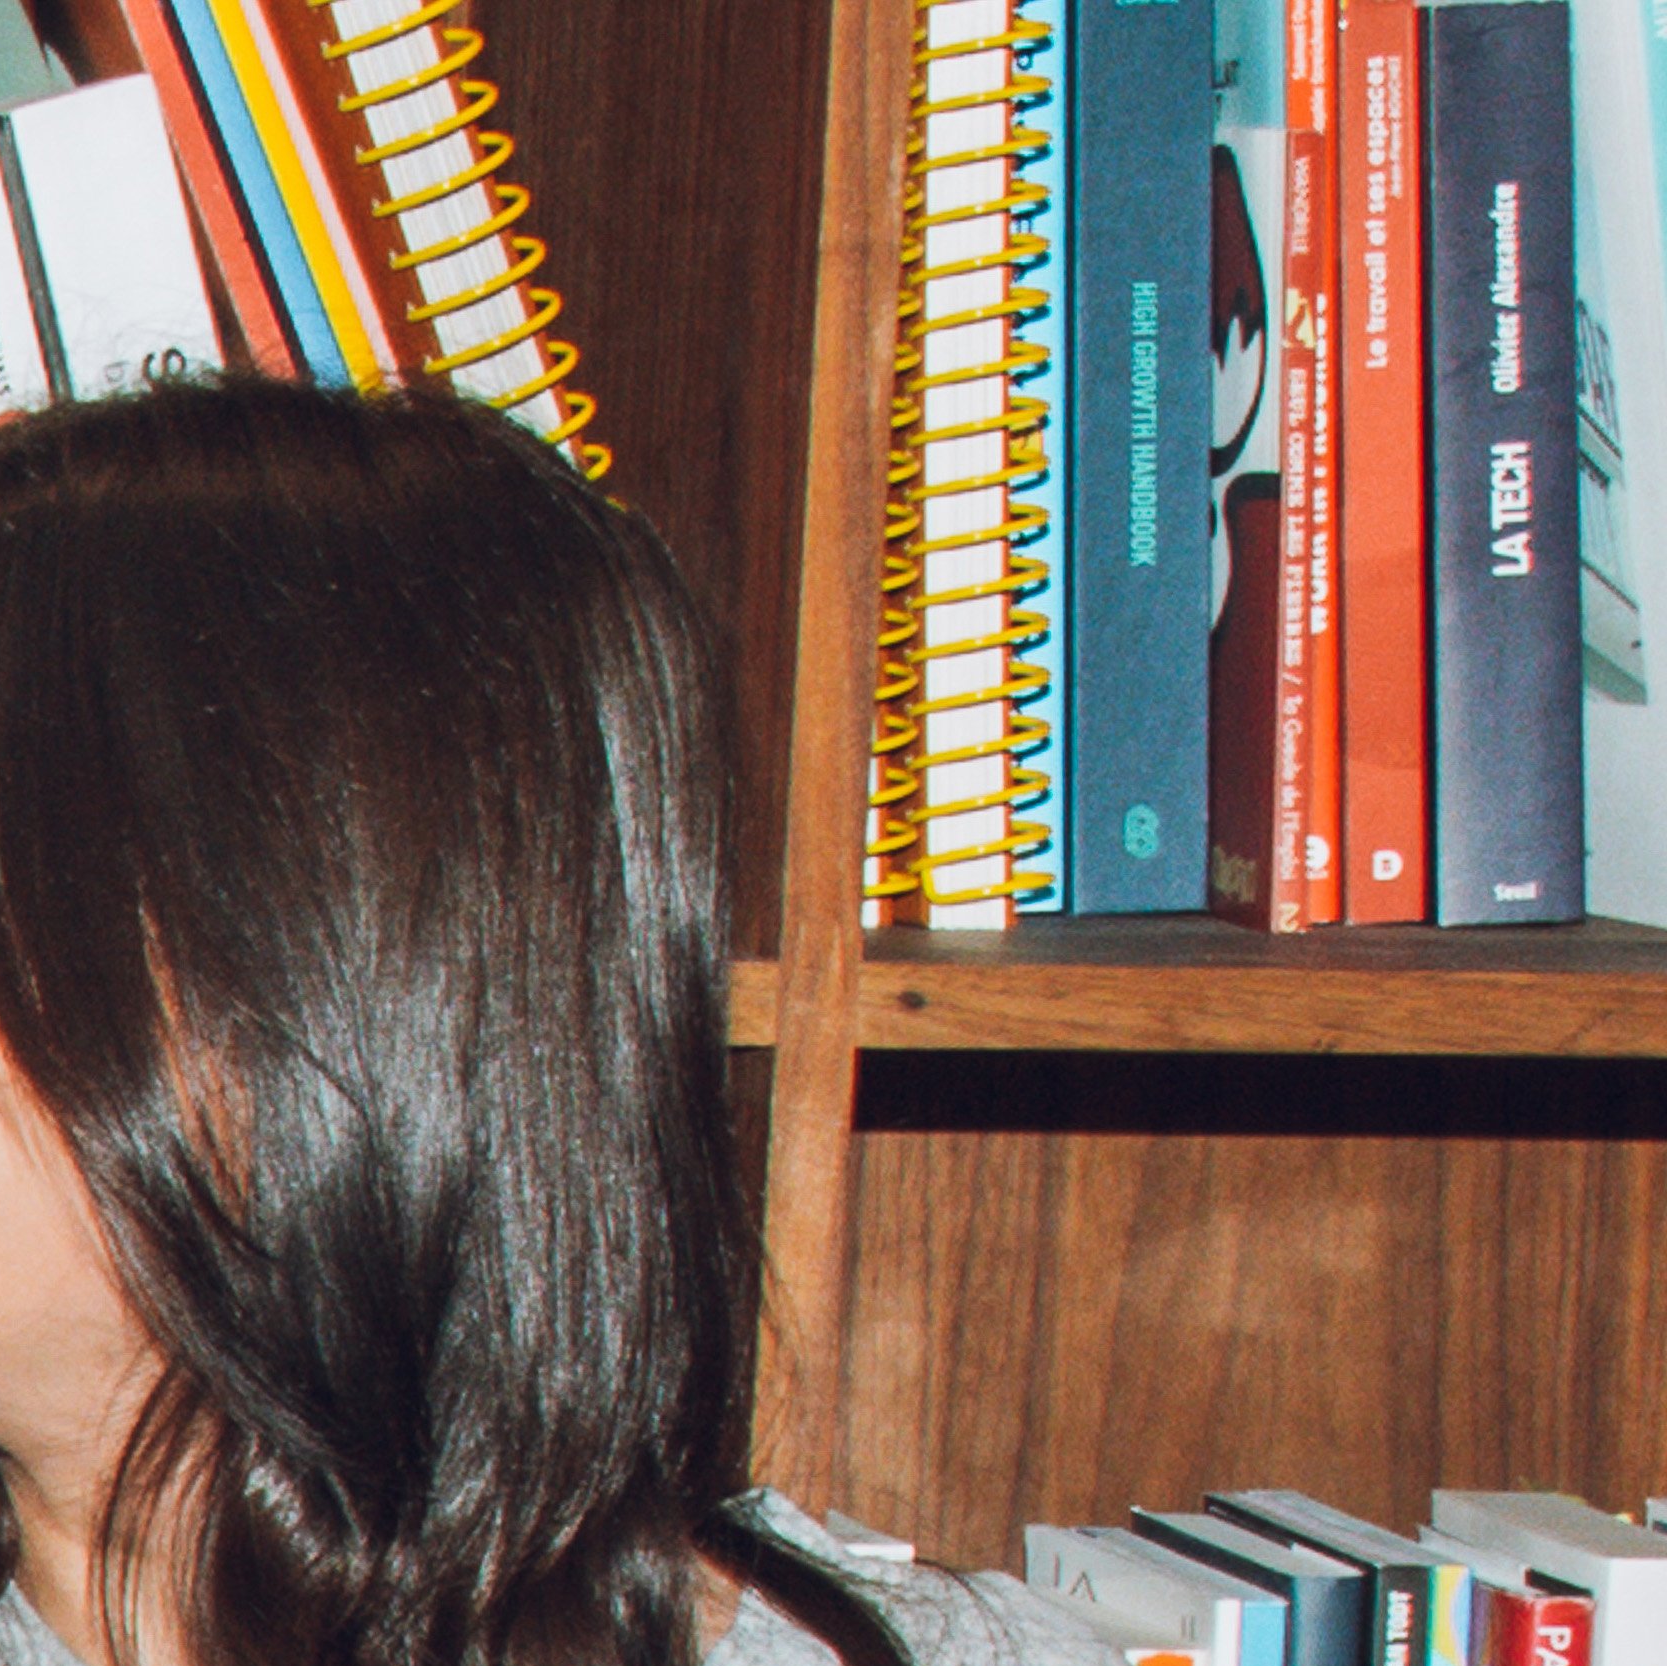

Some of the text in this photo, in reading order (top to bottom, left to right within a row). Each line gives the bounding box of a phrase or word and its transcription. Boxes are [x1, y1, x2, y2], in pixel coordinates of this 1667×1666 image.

[1365, 56, 1388, 368] Le travail et ses espaces
[1490, 181, 1520, 393] Olivier Alexandre
[1129, 282, 1158, 567] HIGH GROWTH HANDBOOK
[1491, 442, 1533, 577] LA TECH
